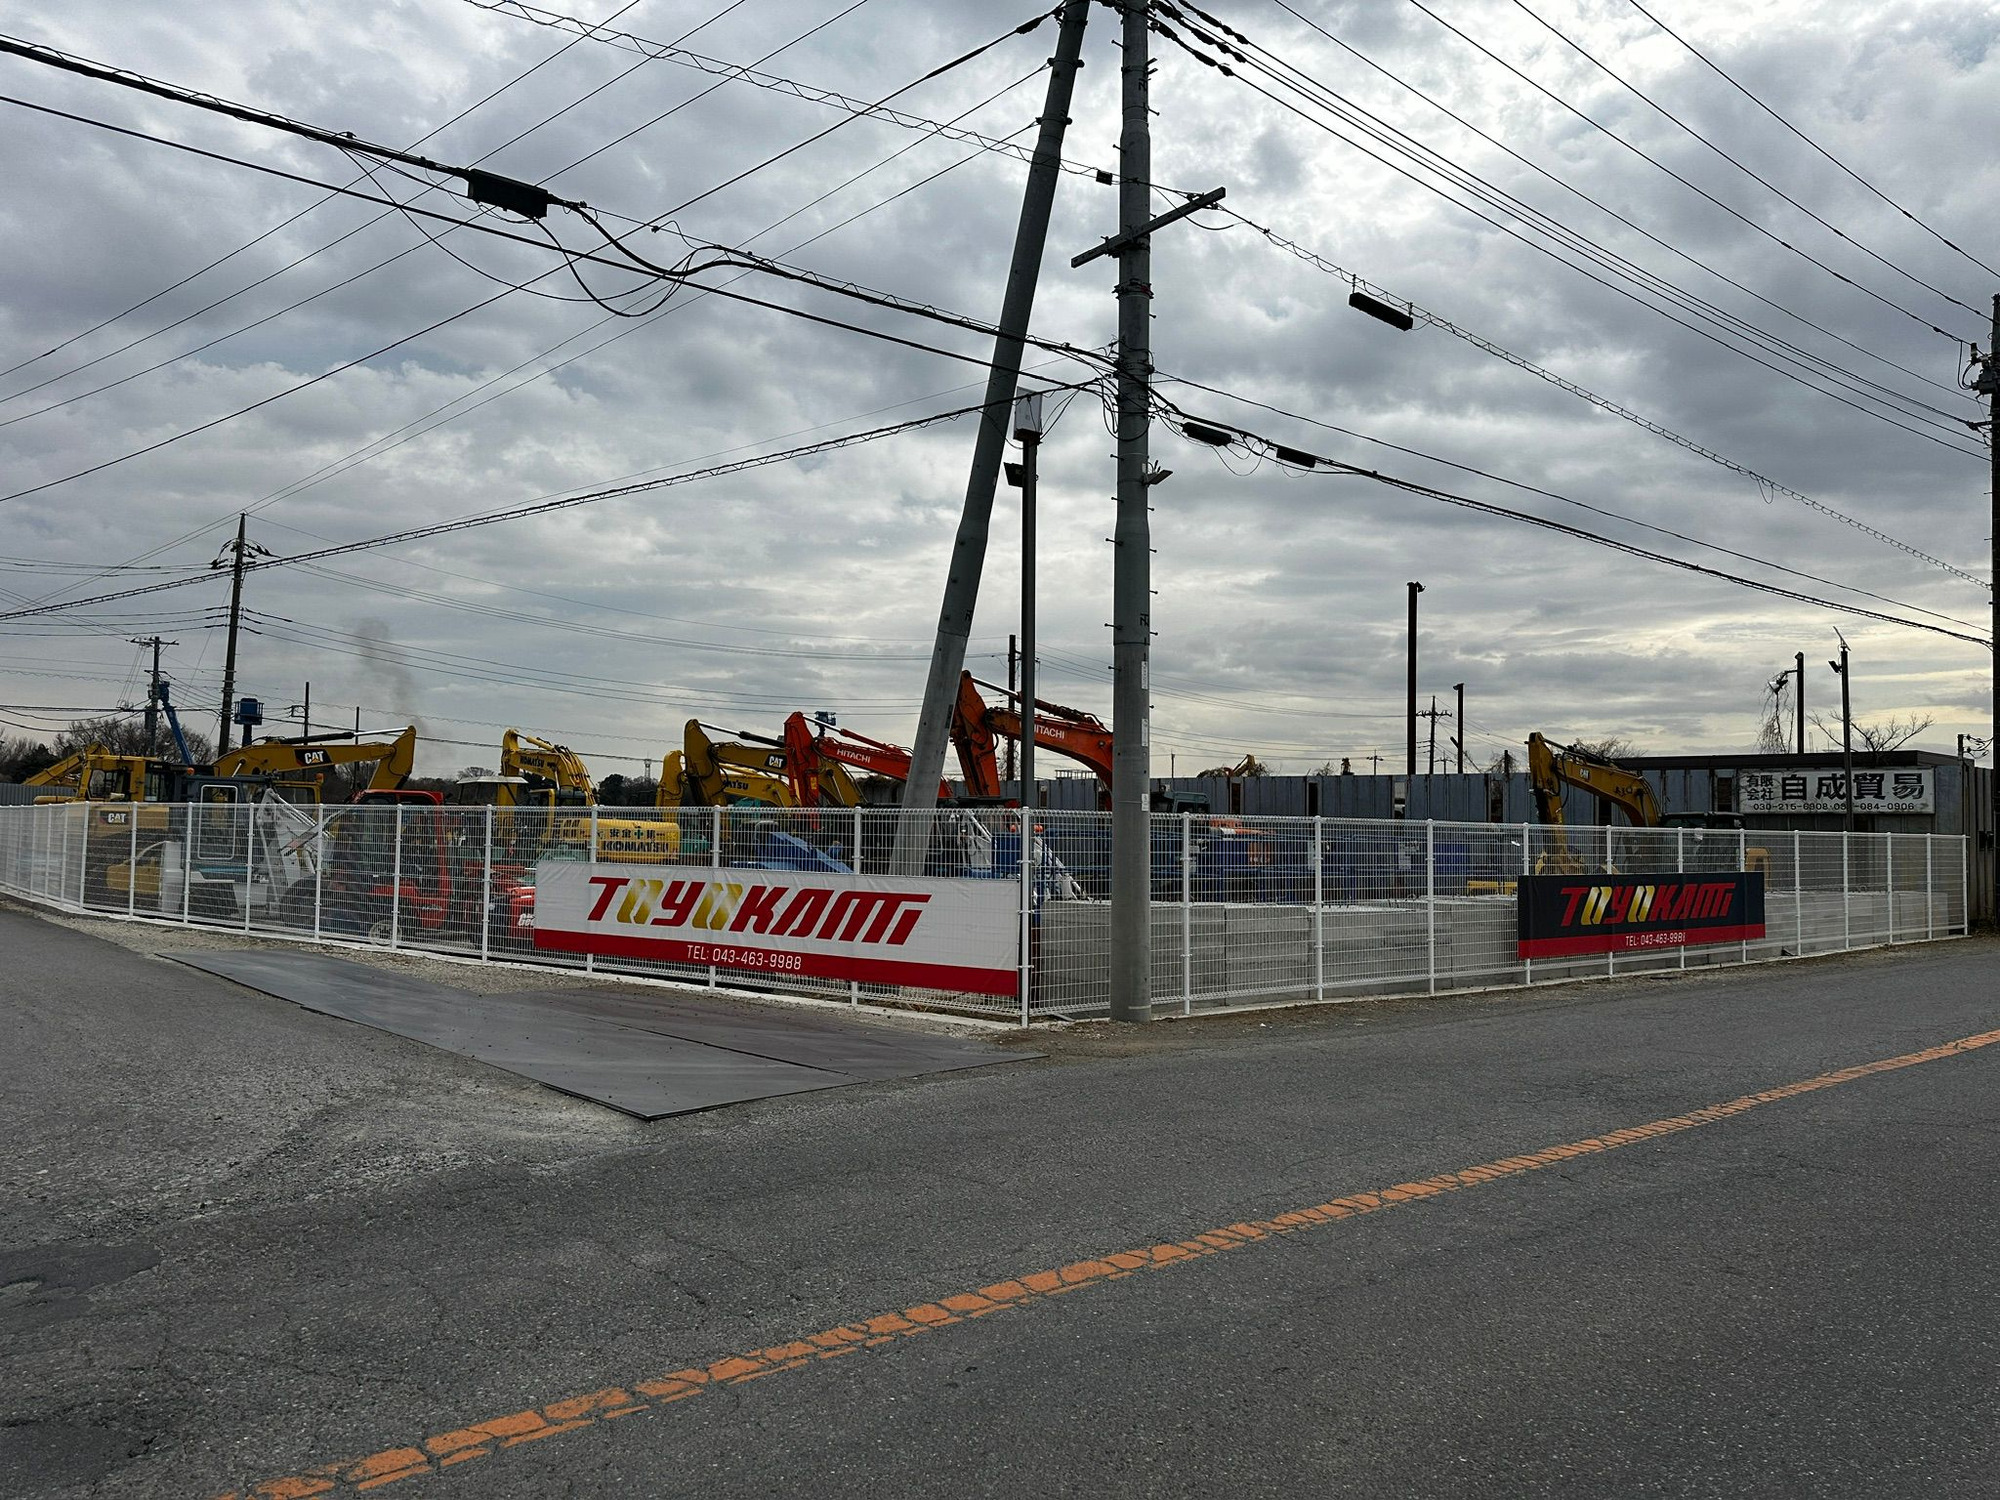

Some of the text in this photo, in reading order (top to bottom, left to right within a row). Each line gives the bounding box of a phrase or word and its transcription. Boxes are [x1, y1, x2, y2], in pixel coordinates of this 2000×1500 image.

[1034, 724, 1065, 739] ITACHI
[304, 751, 324, 764] CAT
[768, 755, 783, 768] CAT
[837, 749, 871, 763] HITACHI
[1781, 773, 1925, 800] 自成貿易
[107, 812, 127, 824] CAT
[603, 841, 669, 852] KOMATSU
[1625, 935, 1640, 946] TEL:
[687, 945, 802, 969] TEL: 043-463-9988
